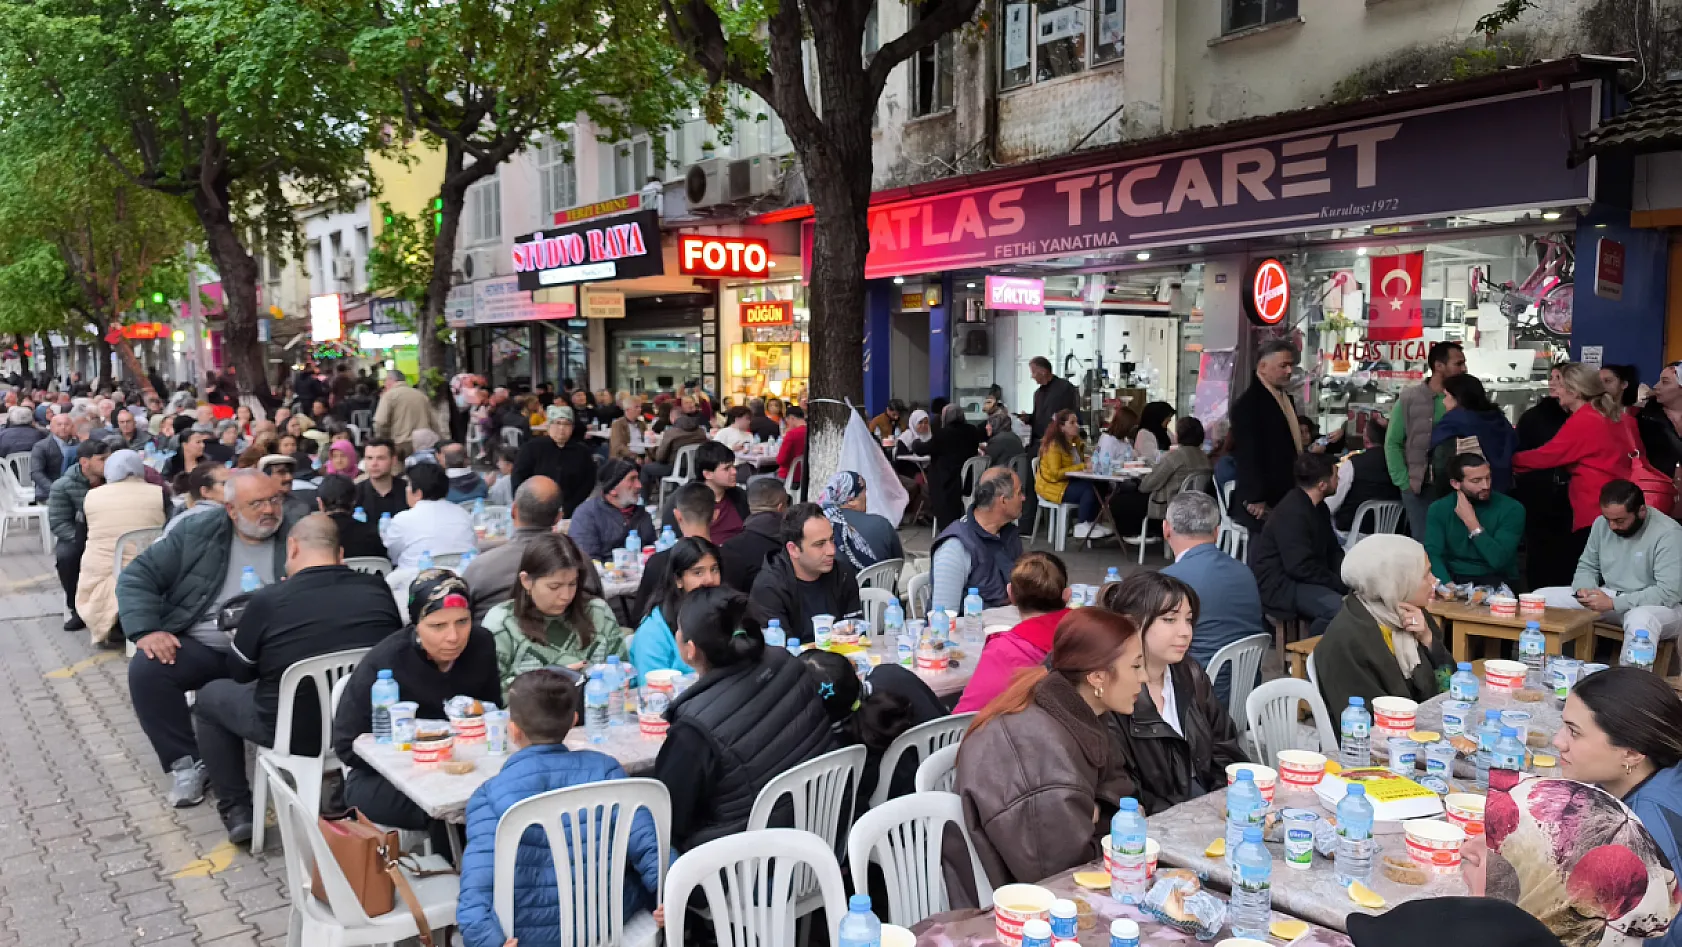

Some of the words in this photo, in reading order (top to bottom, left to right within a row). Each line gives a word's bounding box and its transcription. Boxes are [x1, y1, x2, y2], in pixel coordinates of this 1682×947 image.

[867, 188, 1026, 253] ATLAS
[586, 222, 647, 262] RAYA
[684, 239, 767, 273] FOTO
[1039, 231, 1119, 253] YANATMA
[747, 305, 783, 323] DÜĞÜN
[1332, 341, 1382, 361] ATLAS
